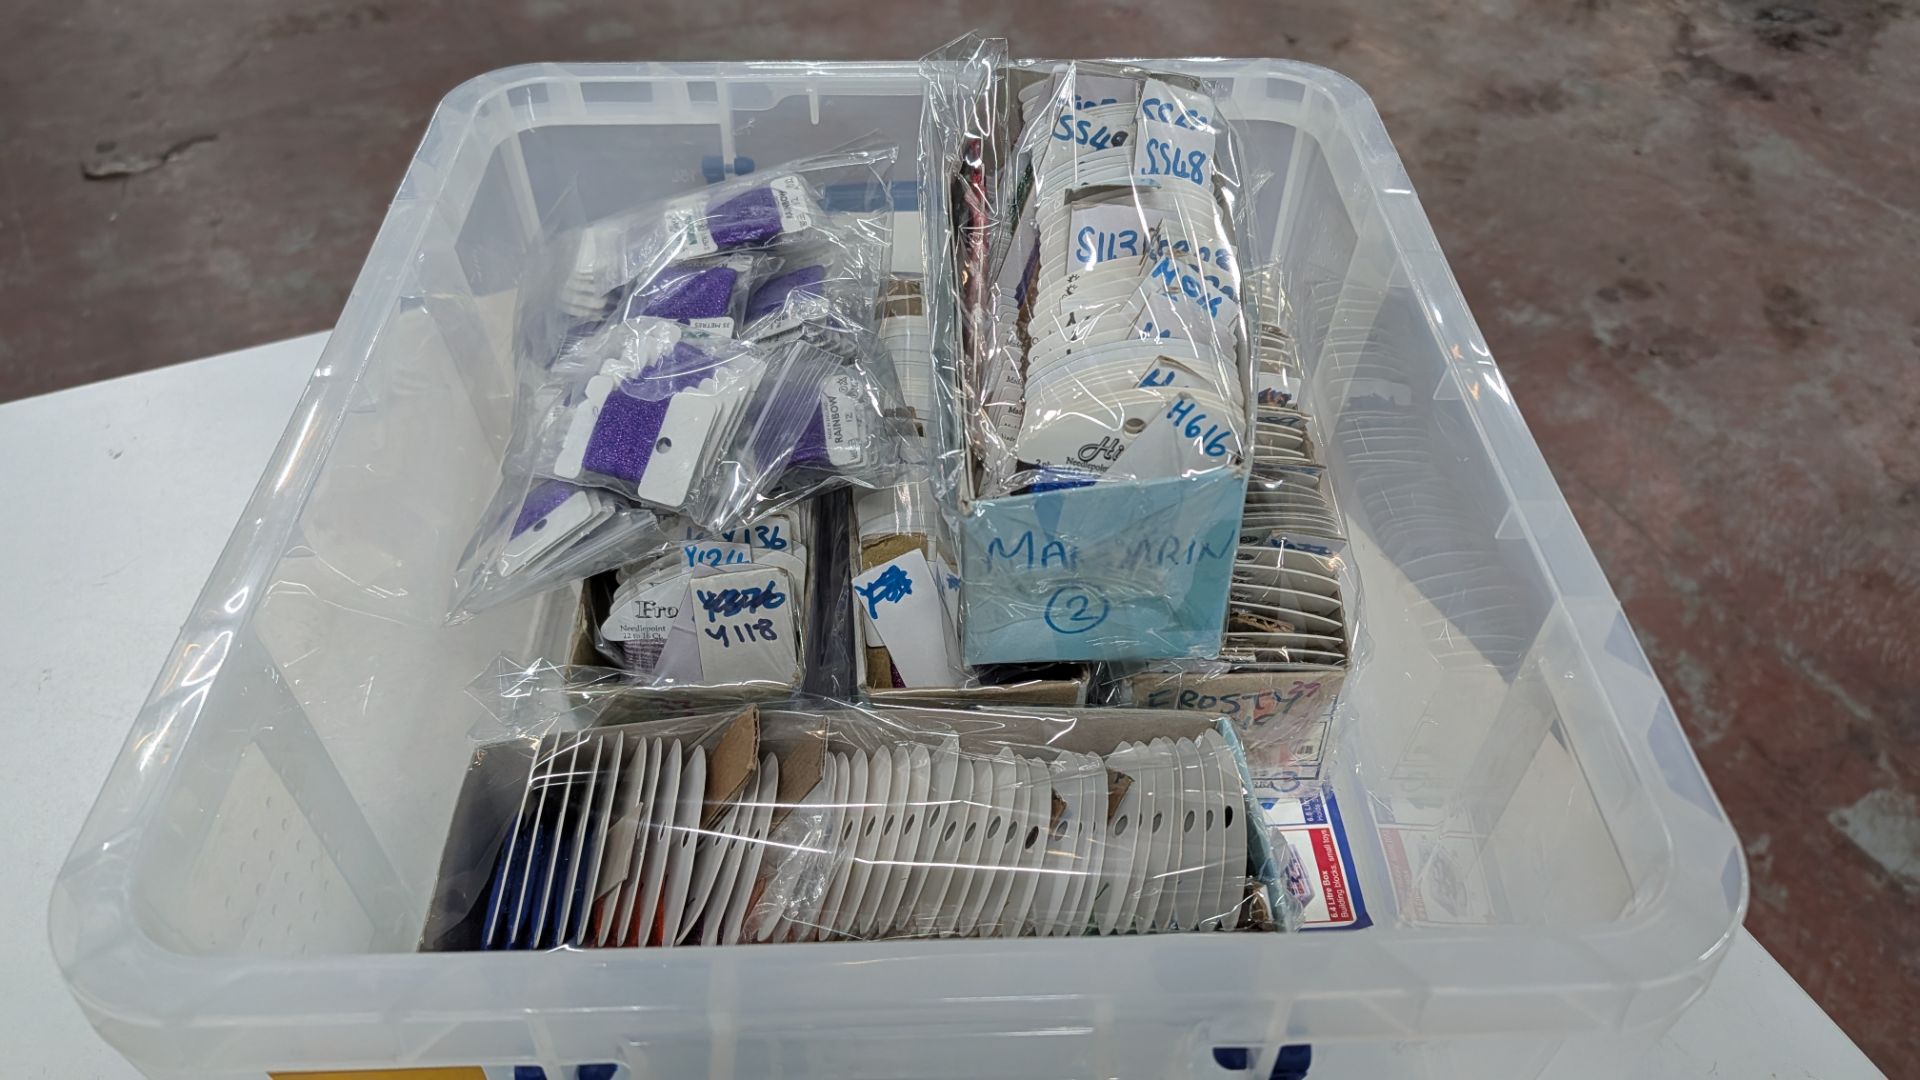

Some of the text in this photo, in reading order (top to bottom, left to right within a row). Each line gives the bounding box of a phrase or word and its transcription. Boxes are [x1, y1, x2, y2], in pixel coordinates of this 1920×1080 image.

[1141, 138, 1207, 185] SS48
[1075, 226, 1139, 264] S113
[827, 395, 844, 444] RAINBOW
[1166, 399, 1231, 457] H616
[635, 600, 679, 619] Fro
[1066, 595, 1102, 621] 2
[1320, 829, 1330, 842] toys
[1323, 844, 1335, 861] small
[1322, 870, 1331, 886] Box
[1326, 888, 1336, 906] Litre
[1336, 889, 1349, 918] Building
